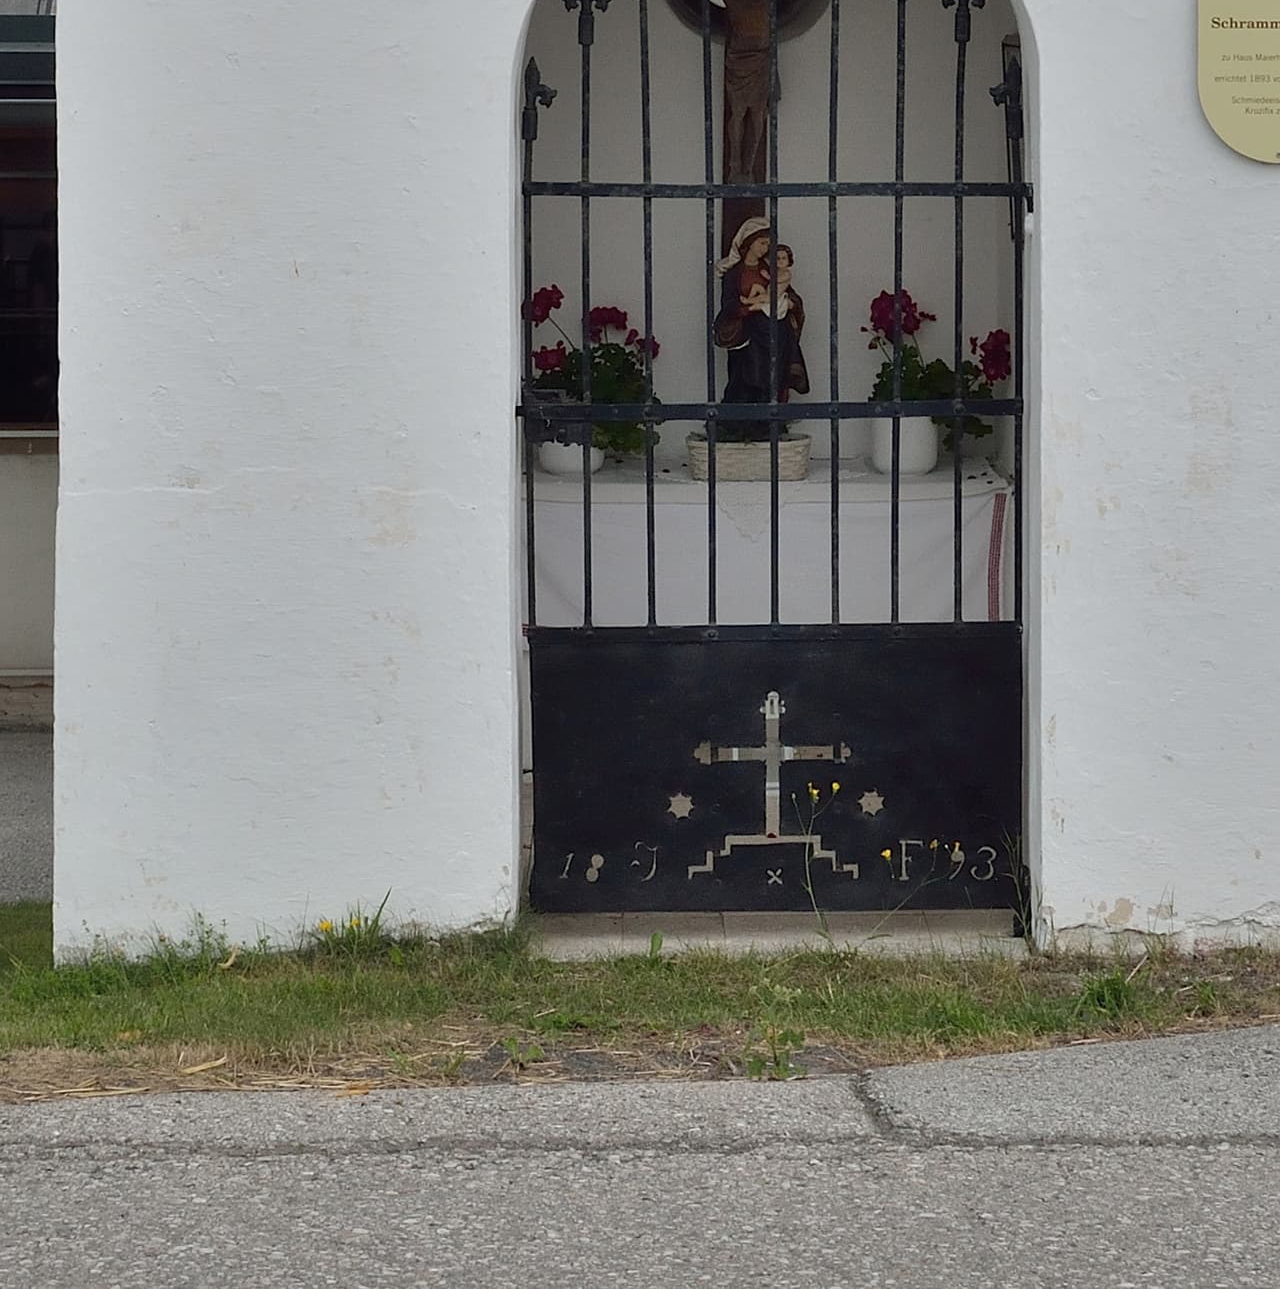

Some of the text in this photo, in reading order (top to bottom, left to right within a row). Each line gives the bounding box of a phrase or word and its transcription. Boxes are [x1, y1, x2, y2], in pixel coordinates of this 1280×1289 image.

[1233, 54, 1253, 62] Haus
[1214, 75, 1247, 83] errichtet
[1249, 75, 1271, 83] 1893
